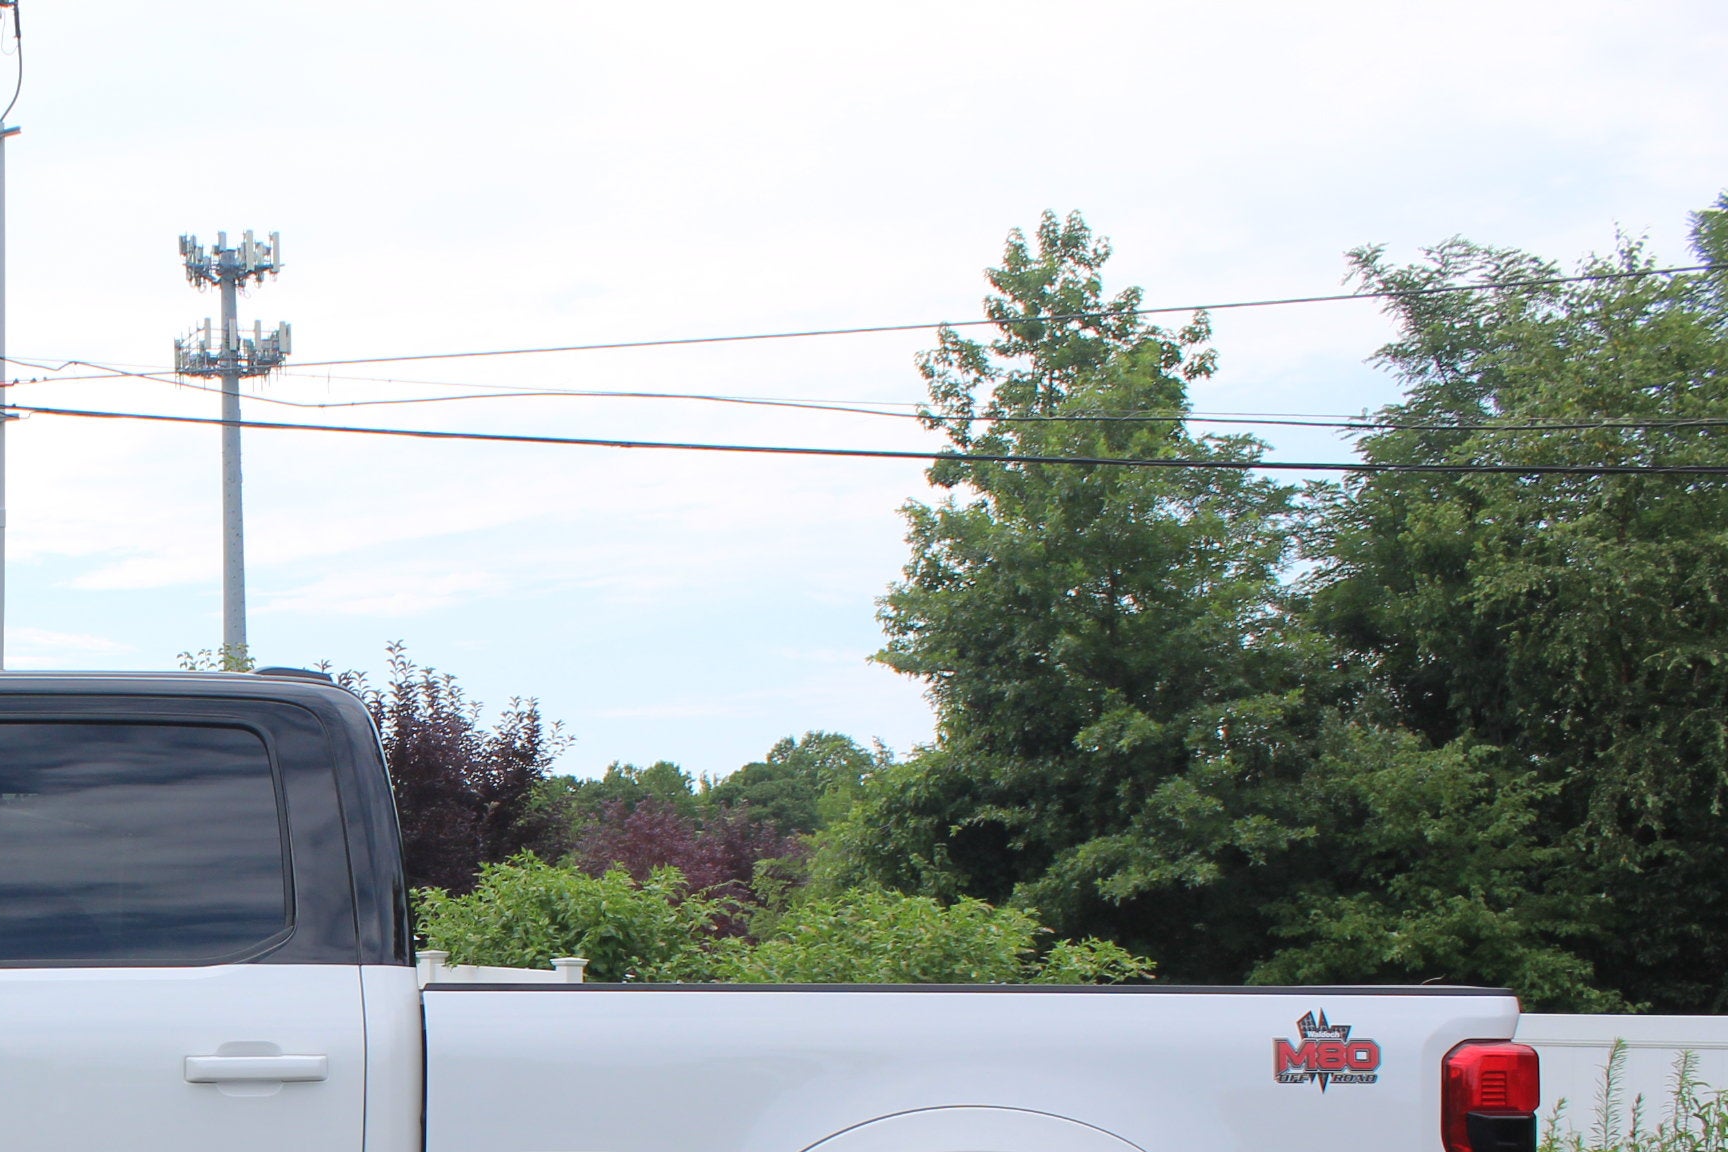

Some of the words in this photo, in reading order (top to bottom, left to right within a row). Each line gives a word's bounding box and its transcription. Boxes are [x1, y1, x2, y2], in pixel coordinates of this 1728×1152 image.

[1307, 1030, 1341, 1039] Waldoch
[1273, 1038, 1381, 1073] M80
[1278, 1073, 1310, 1084] OFF
[1331, 1073, 1378, 1084] ROAD
